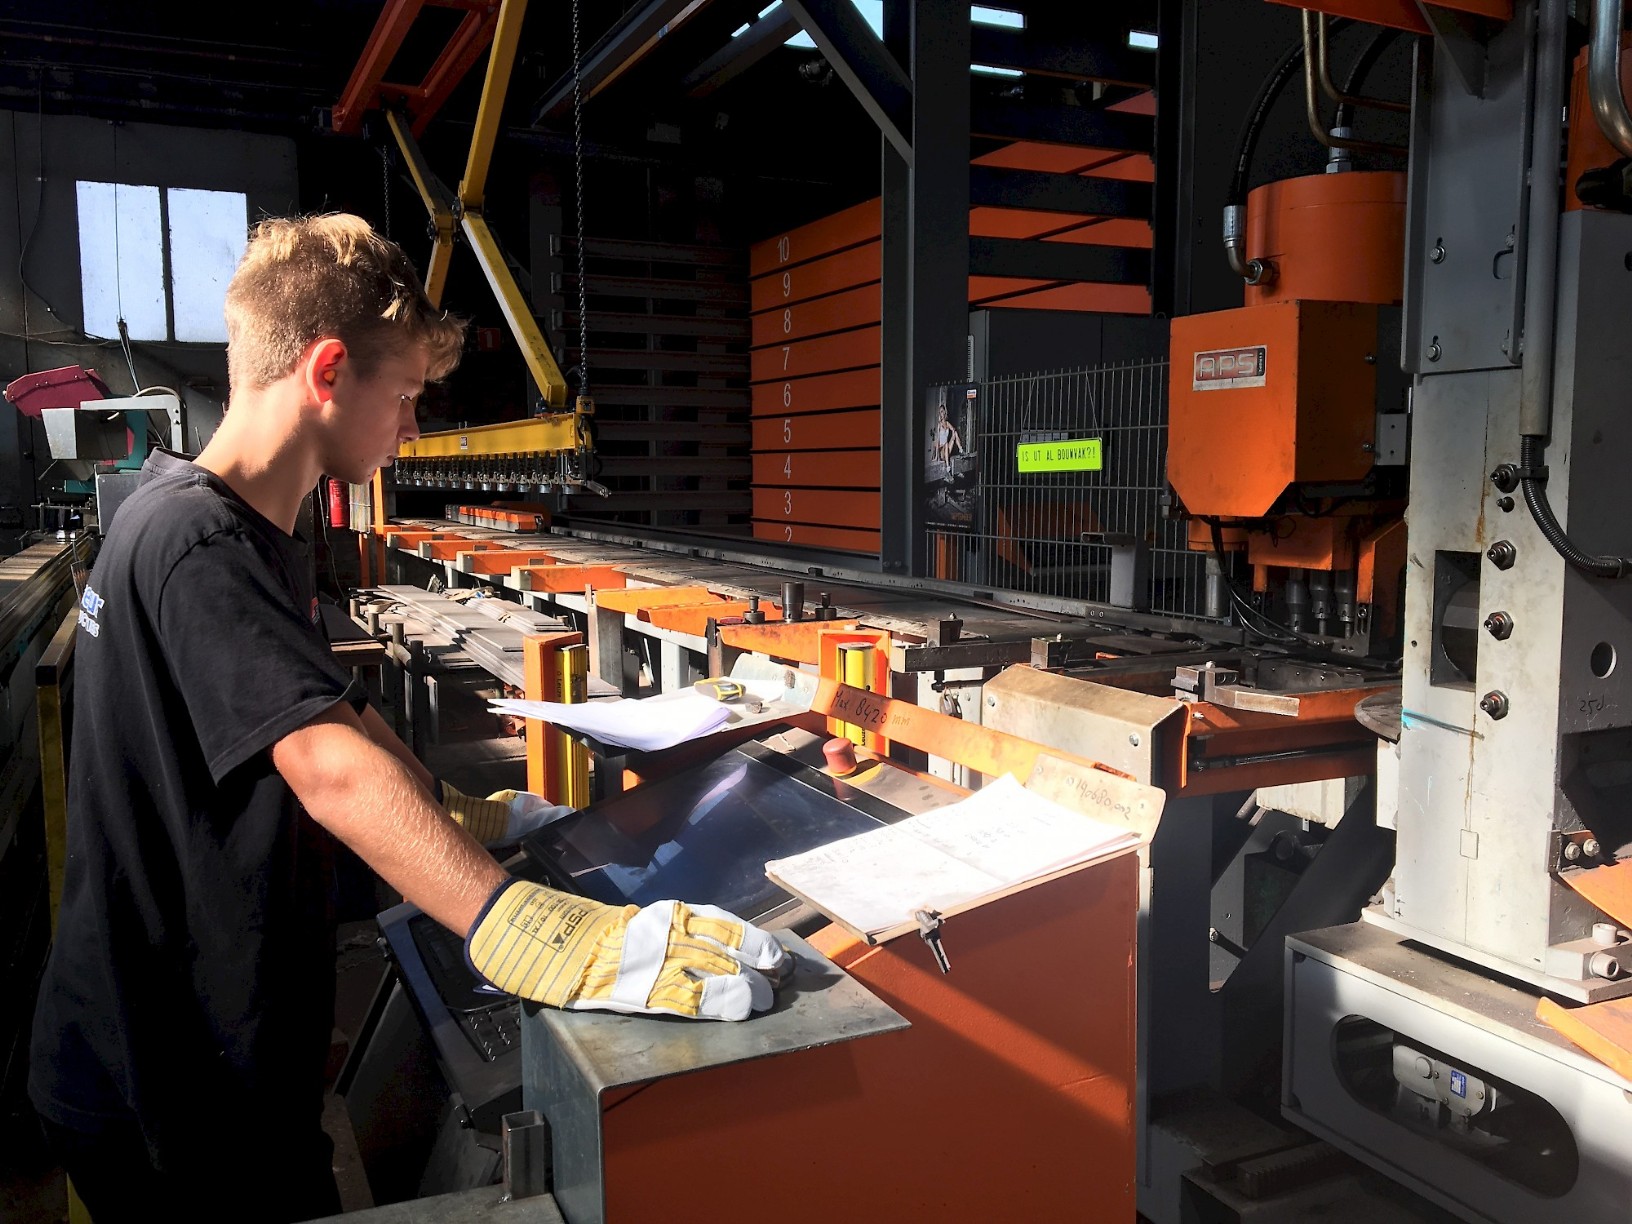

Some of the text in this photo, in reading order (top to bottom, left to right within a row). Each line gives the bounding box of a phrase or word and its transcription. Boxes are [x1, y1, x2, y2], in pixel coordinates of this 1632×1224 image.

[777, 236, 790, 263] 10
[783, 272, 791, 297] 9
[784, 308, 791, 334] 8
[782, 346, 790, 371] 7
[1200, 353, 1255, 377] APS
[783, 382, 791, 407] 6
[783, 419, 791, 444] 5
[783, 454, 792, 479] 4
[1022, 446, 1096, 462] IS UT AL BOUWVAK?!
[784, 490, 792, 515] 3
[831, 690, 911, 726] Max 8420 mm
